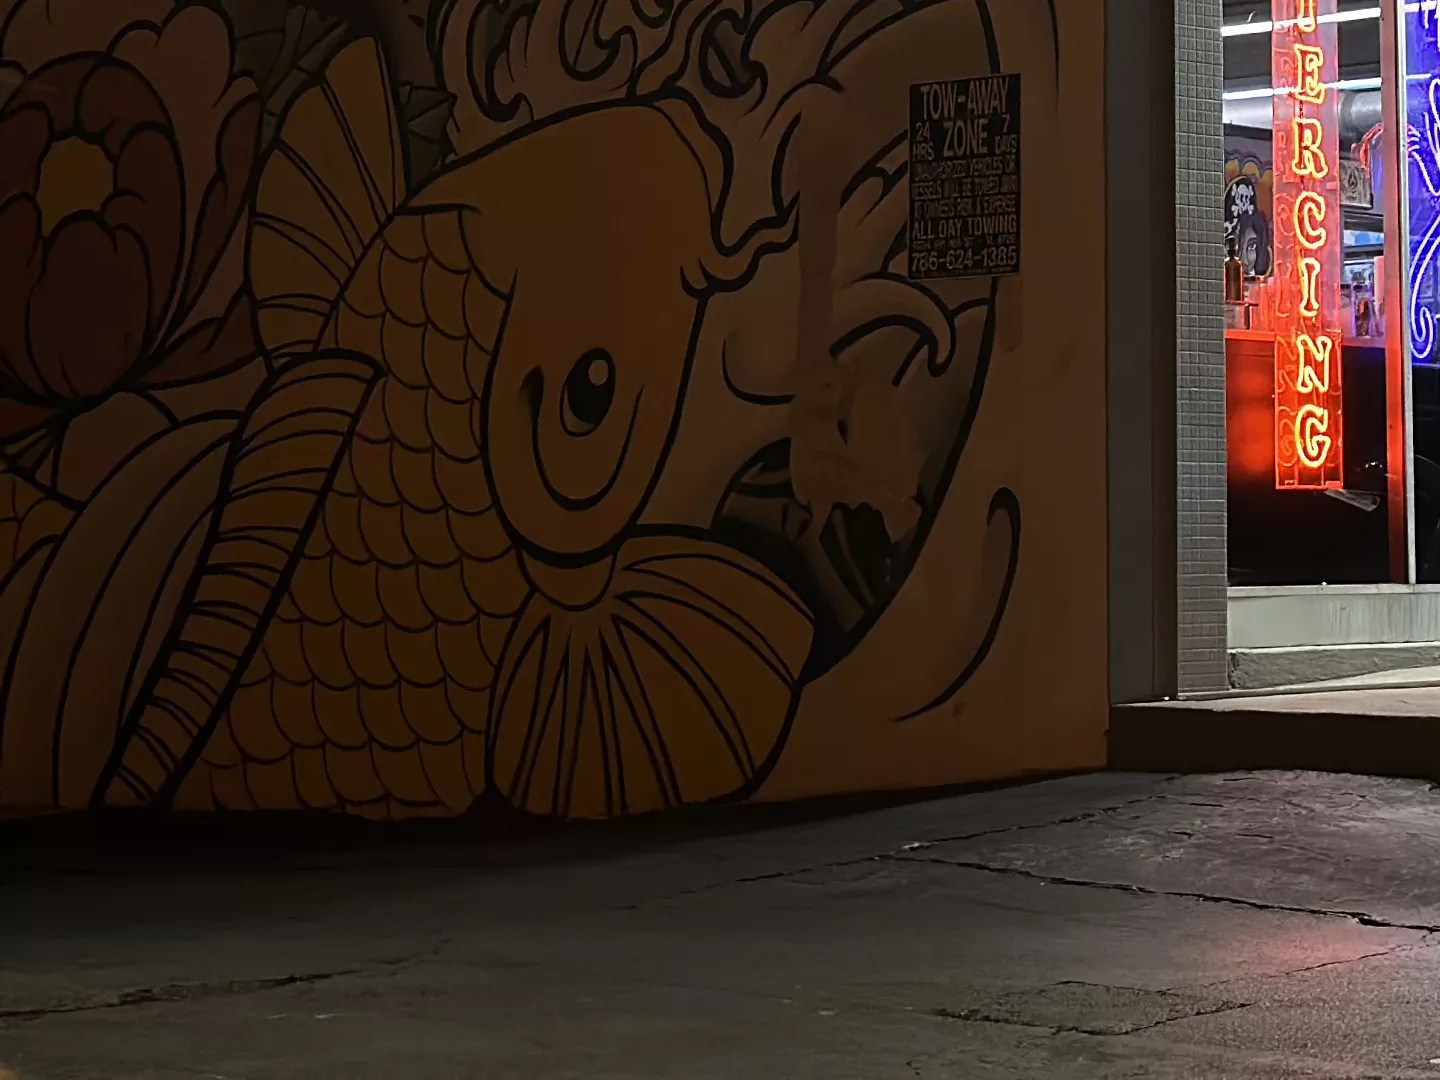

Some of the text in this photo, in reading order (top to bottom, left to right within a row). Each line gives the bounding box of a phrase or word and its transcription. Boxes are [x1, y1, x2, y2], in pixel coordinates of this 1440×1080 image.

[920, 77, 1010, 120] TOW-AWAY
[916, 122, 931, 142] 24
[1002, 113, 1011, 133] 7
[943, 118, 989, 157] ZONE
[912, 142, 935, 162] HRS
[911, 214, 1017, 240] ALL DAY TOWING
